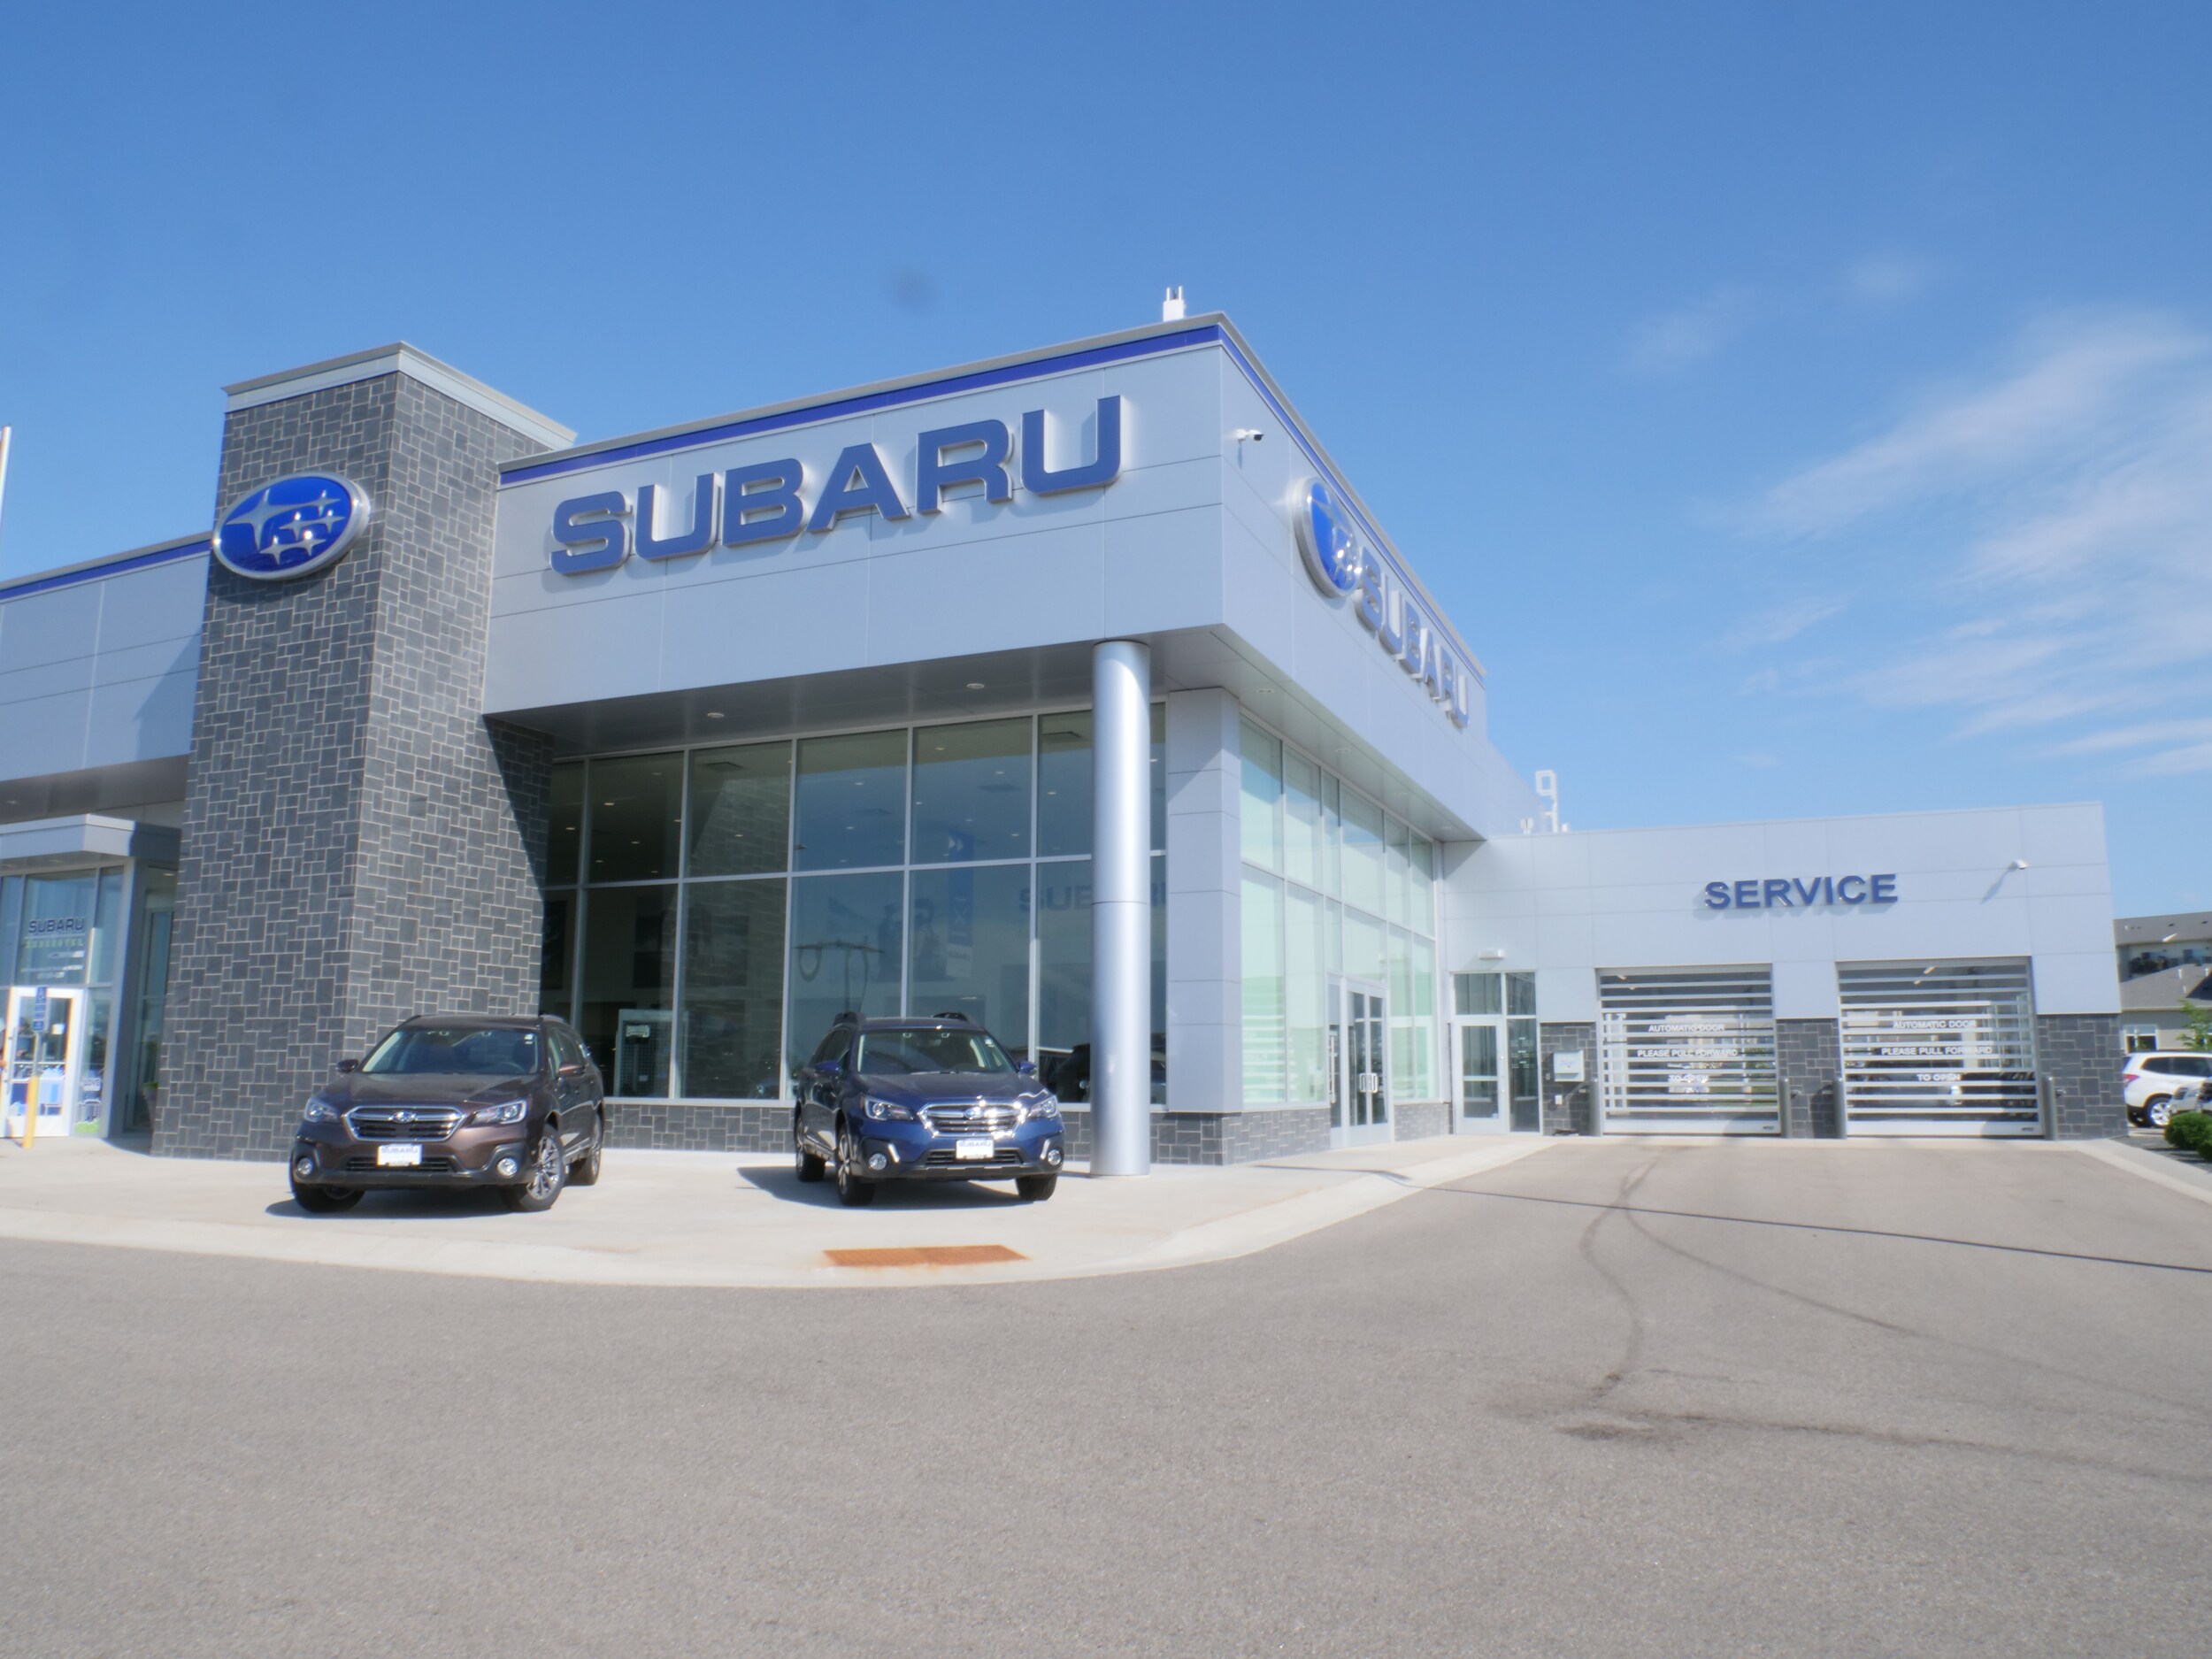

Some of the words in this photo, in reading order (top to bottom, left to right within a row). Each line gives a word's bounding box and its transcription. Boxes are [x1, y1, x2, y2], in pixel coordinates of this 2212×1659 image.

[549, 395, 1123, 576] SUBARU
[1356, 546, 1470, 730] SUBARU
[1704, 873, 1898, 910] SERVICE
[28, 918, 85, 933] SUBARU
[1893, 1020, 1947, 1029] AUTOMATIC
[1695, 1048, 1738, 1057] FORWARD
[1945, 1046, 1992, 1055] FORWARD
